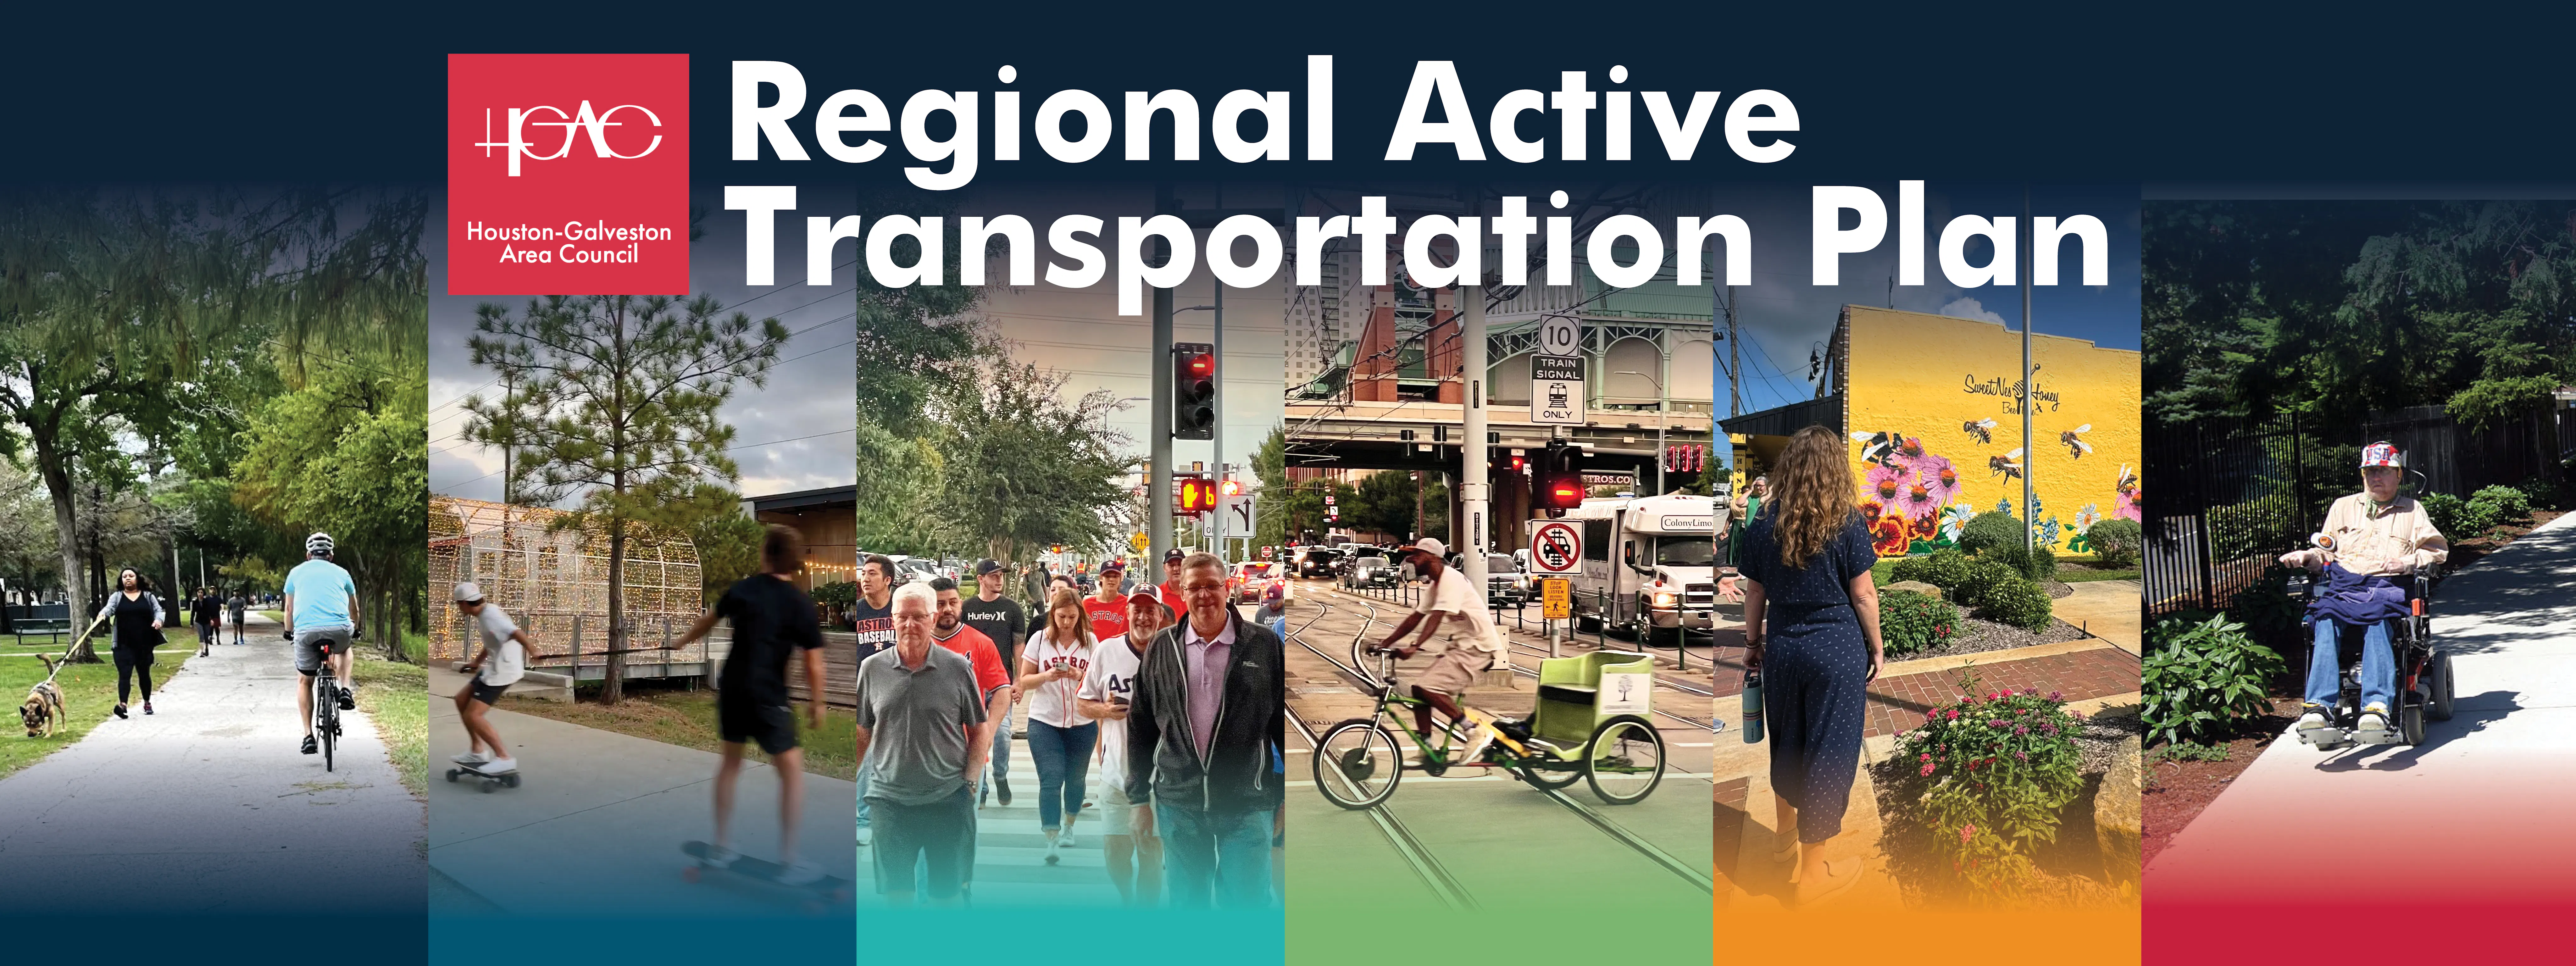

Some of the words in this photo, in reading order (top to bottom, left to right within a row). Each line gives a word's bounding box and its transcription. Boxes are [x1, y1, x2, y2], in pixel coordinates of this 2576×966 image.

[1549, 326, 1571, 346] 10
[1541, 358, 1576, 367] TRAIN
[1537, 370, 1580, 379] SIGNAL
[2031, 383, 2060, 411] Honey
[2366, 447, 2390, 460] USA
[968, 612, 996, 620] Hurley
[1090, 610, 1124, 625] STROS
[858, 618, 894, 632] ASTRO
[858, 630, 897, 645] BASEBAL
[1043, 656, 1089, 671] ASTRO
